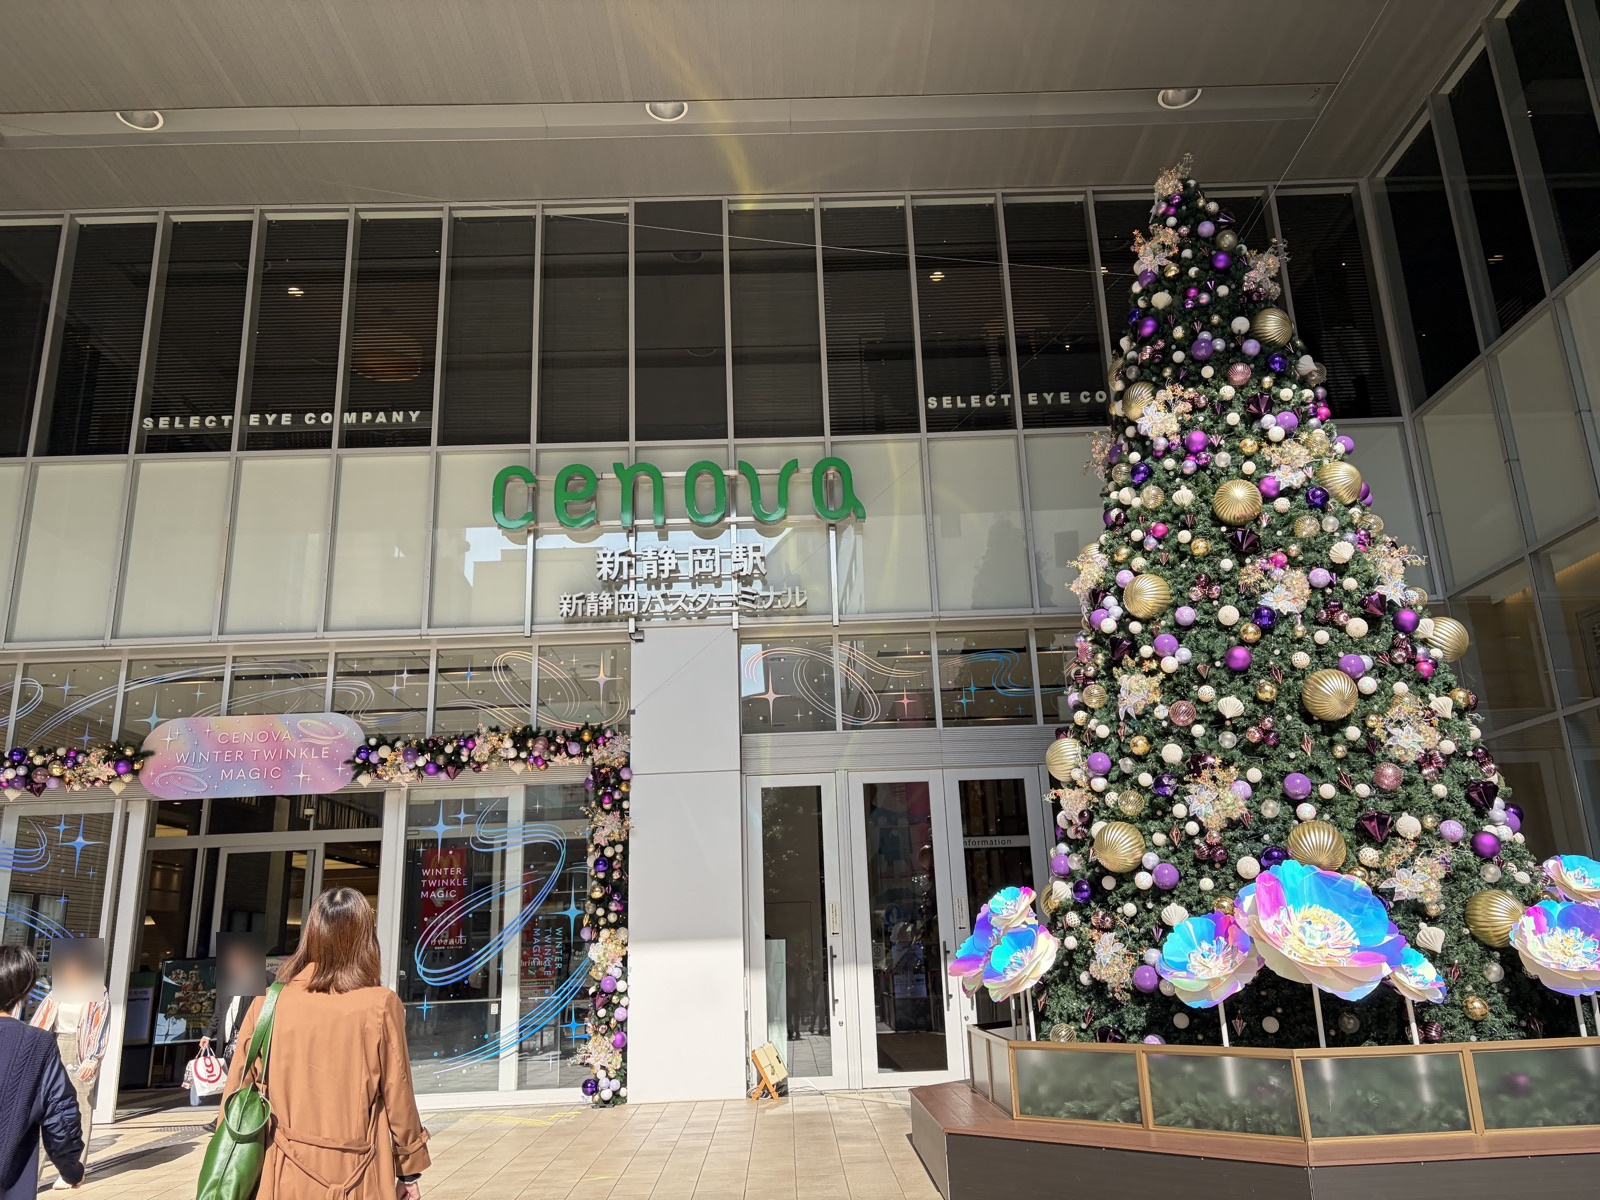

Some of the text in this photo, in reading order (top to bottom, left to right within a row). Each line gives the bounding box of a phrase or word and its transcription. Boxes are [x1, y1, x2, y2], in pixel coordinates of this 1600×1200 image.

[927, 393, 1011, 409] SELECT
[1027, 391, 1071, 405] EYE
[142, 410, 421, 430] SELECT EYE COMPANY
[492, 456, 867, 531] cenova
[596, 543, 768, 581] 新静岡駅
[558, 585, 808, 618] 新静岡バスターミナル
[217, 729, 293, 745] CENOVA
[175, 746, 330, 764] WINTER TWINKLE
[220, 766, 283, 781] MAGIC
[963, 838, 1012, 847] nformation
[421, 867, 462, 876] WINTER
[420, 878, 468, 887] TWINKLE
[420, 889, 457, 899] MAGIC
[533, 928, 541, 966] MAGIC
[554, 927, 563, 969] WINTER
